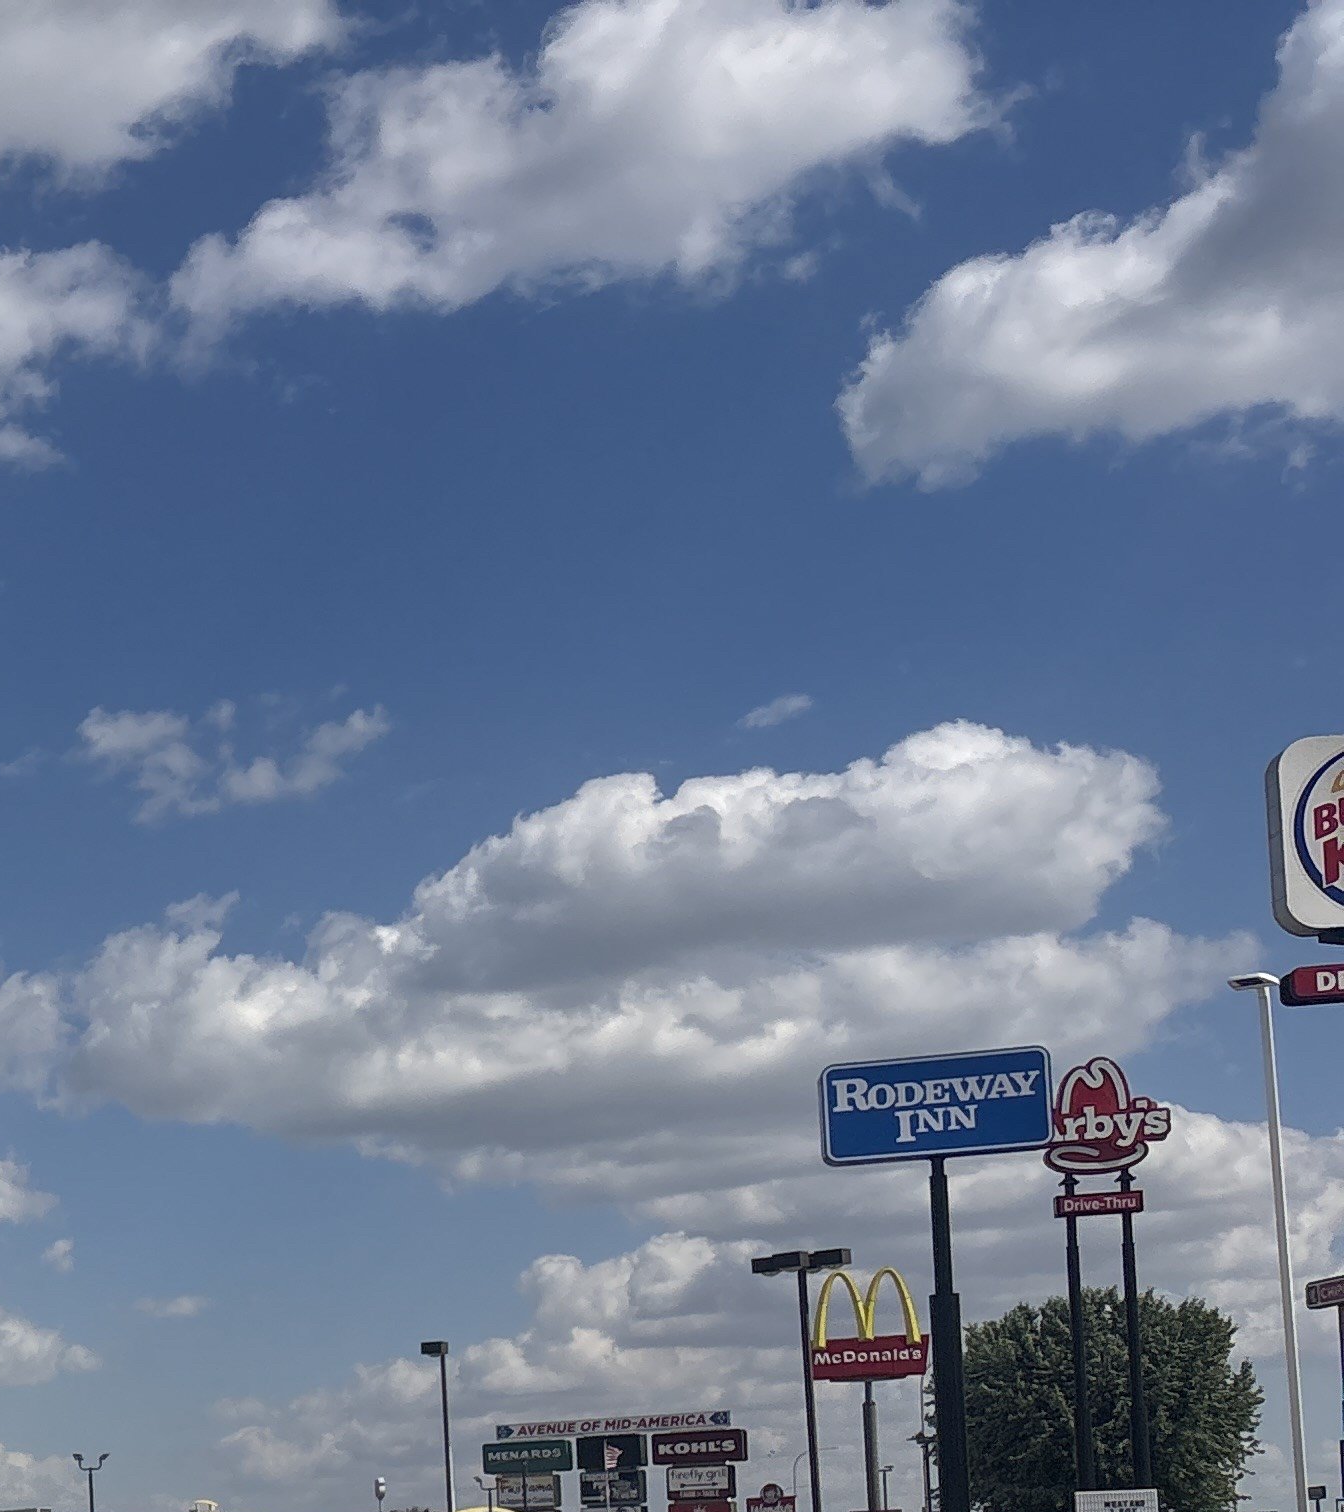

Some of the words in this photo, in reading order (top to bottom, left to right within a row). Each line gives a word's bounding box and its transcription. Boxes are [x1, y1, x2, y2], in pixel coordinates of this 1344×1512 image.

[832, 1069, 1040, 1112] RODEWAY
[895, 1104, 980, 1144] INN
[1063, 1197, 1137, 1212] Drive-Thru
[814, 1348, 922, 1365] McDonald's
[517, 1421, 576, 1437] AVENUE
[580, 1420, 601, 1432] OF
[604, 1413, 707, 1431] MID-AMERICA
[488, 1447, 561, 1461] MENARDS
[657, 1439, 736, 1455] KOHL'S
